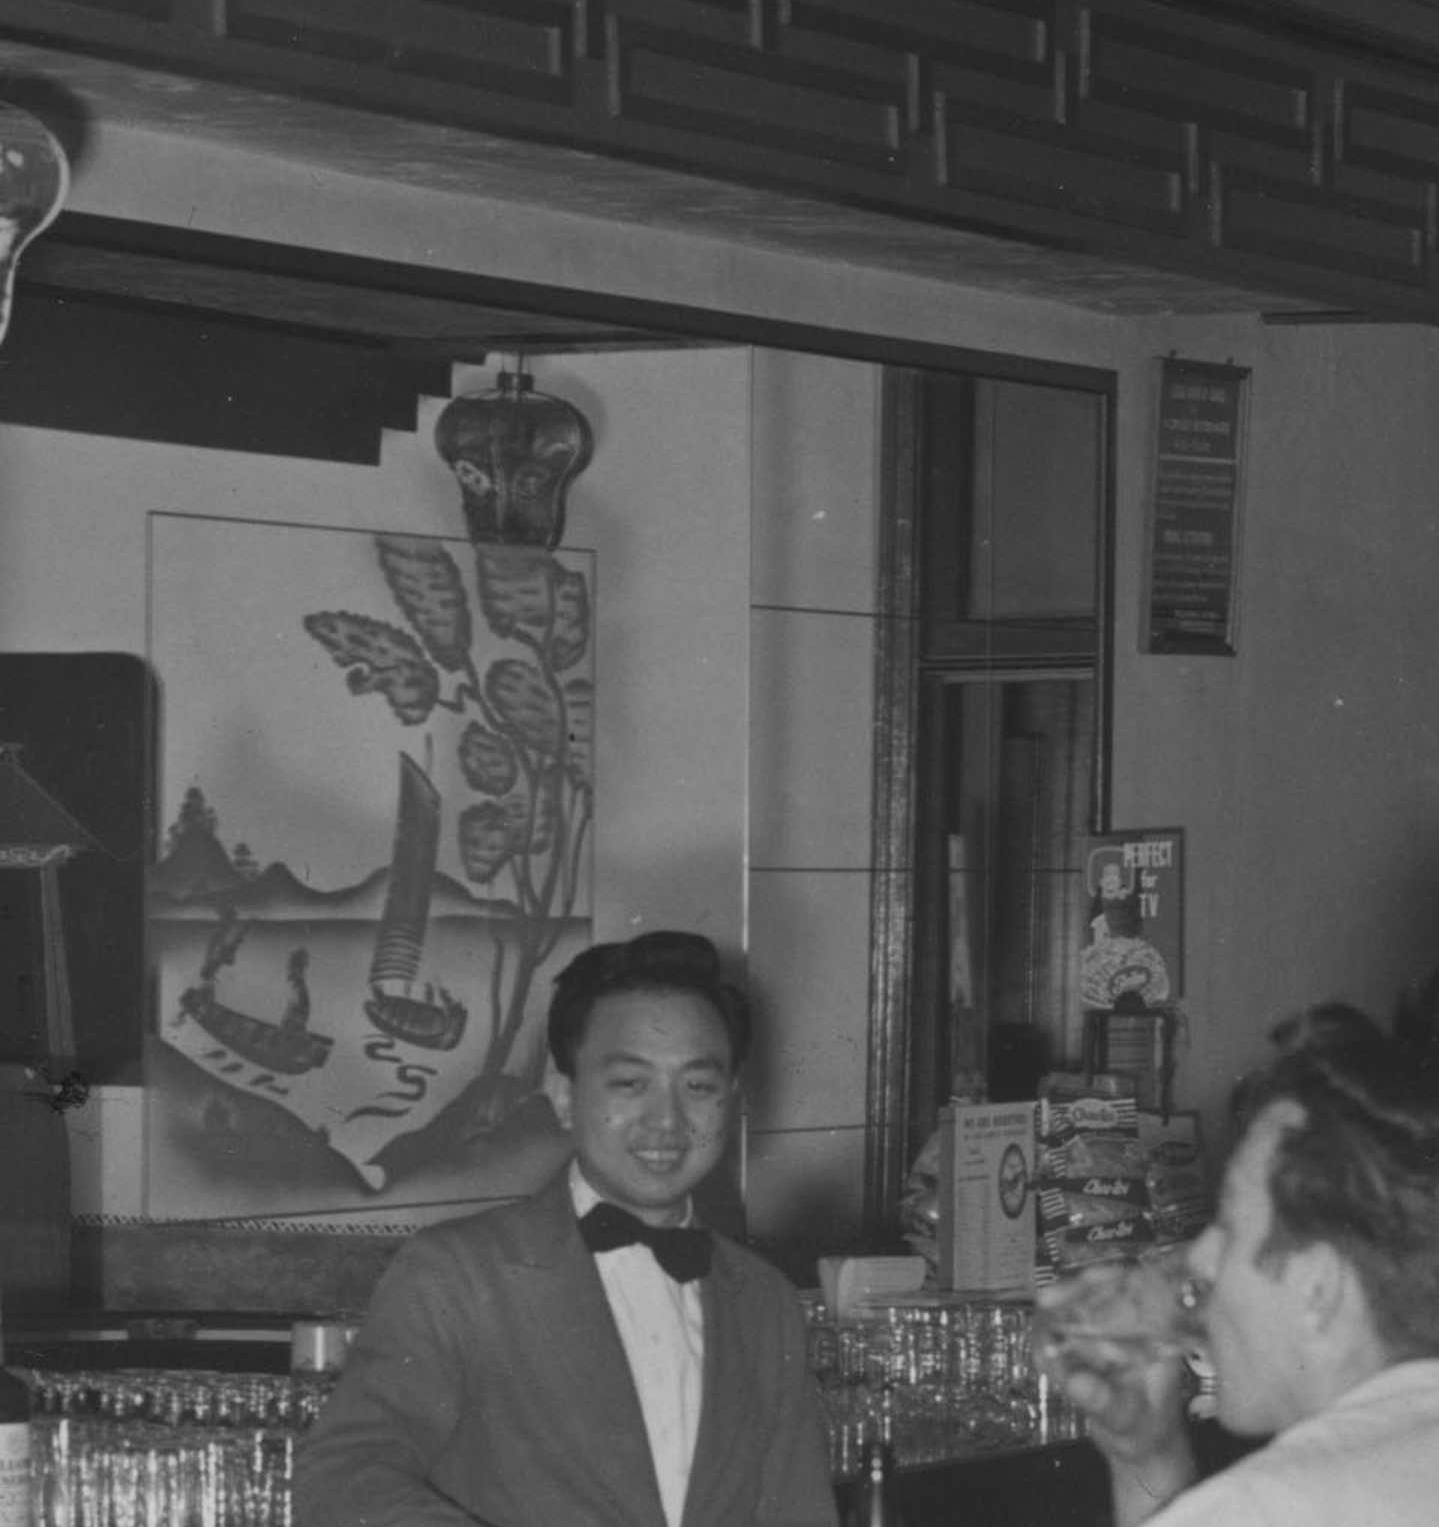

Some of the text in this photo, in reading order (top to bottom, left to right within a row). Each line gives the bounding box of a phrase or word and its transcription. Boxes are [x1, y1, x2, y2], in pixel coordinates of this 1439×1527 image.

[1123, 840, 1172, 868] PERFECT
[1140, 869, 1159, 888] for
[1138, 892, 1160, 918] TV
